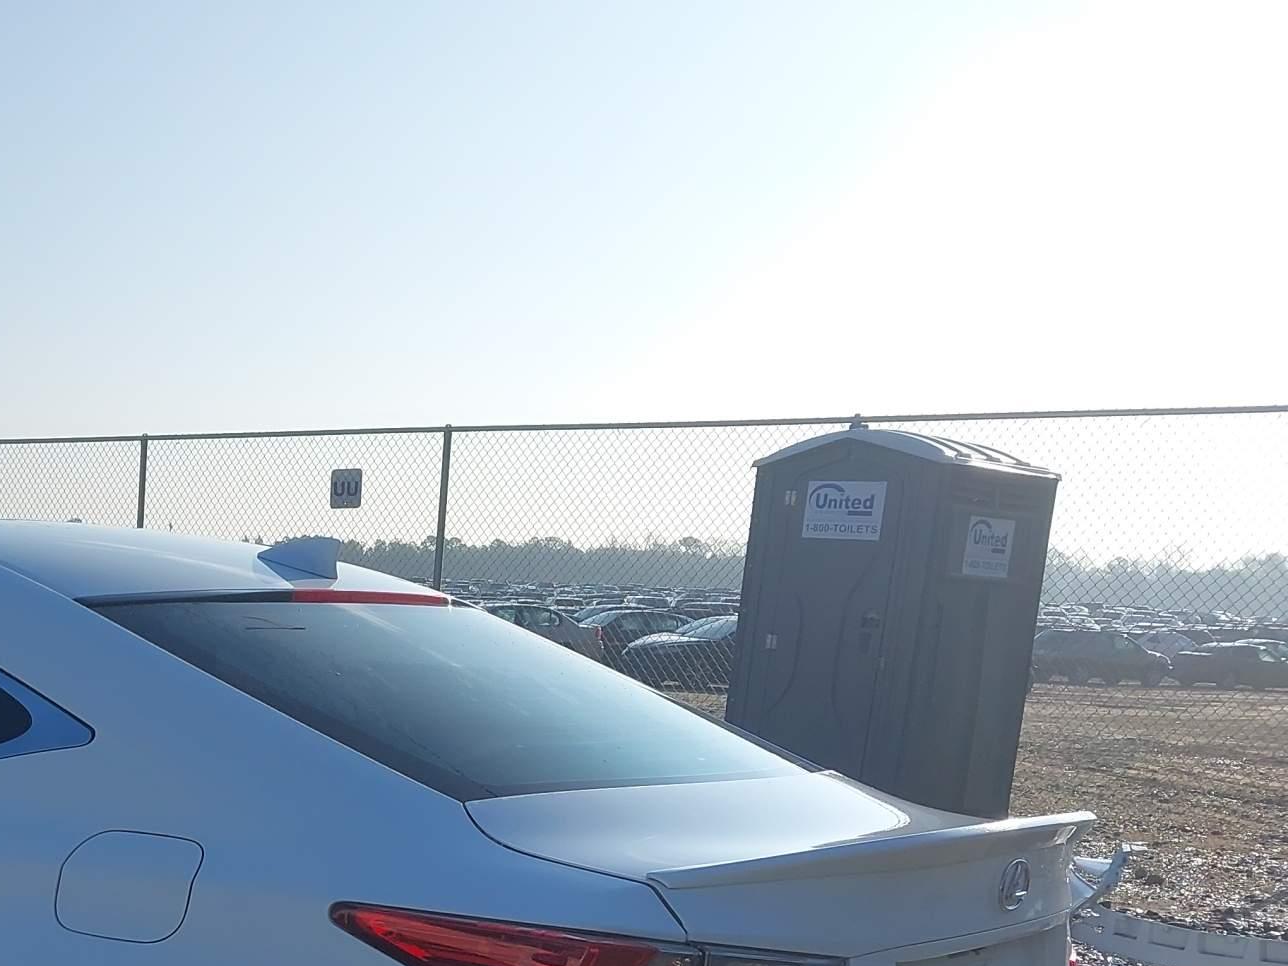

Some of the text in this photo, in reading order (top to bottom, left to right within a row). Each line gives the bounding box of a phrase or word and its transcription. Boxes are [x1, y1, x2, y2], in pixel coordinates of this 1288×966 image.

[333, 480, 359, 497] UU
[815, 492, 876, 510] United
[806, 523, 879, 535] 1-800-TOILETS
[973, 528, 1009, 548] United
